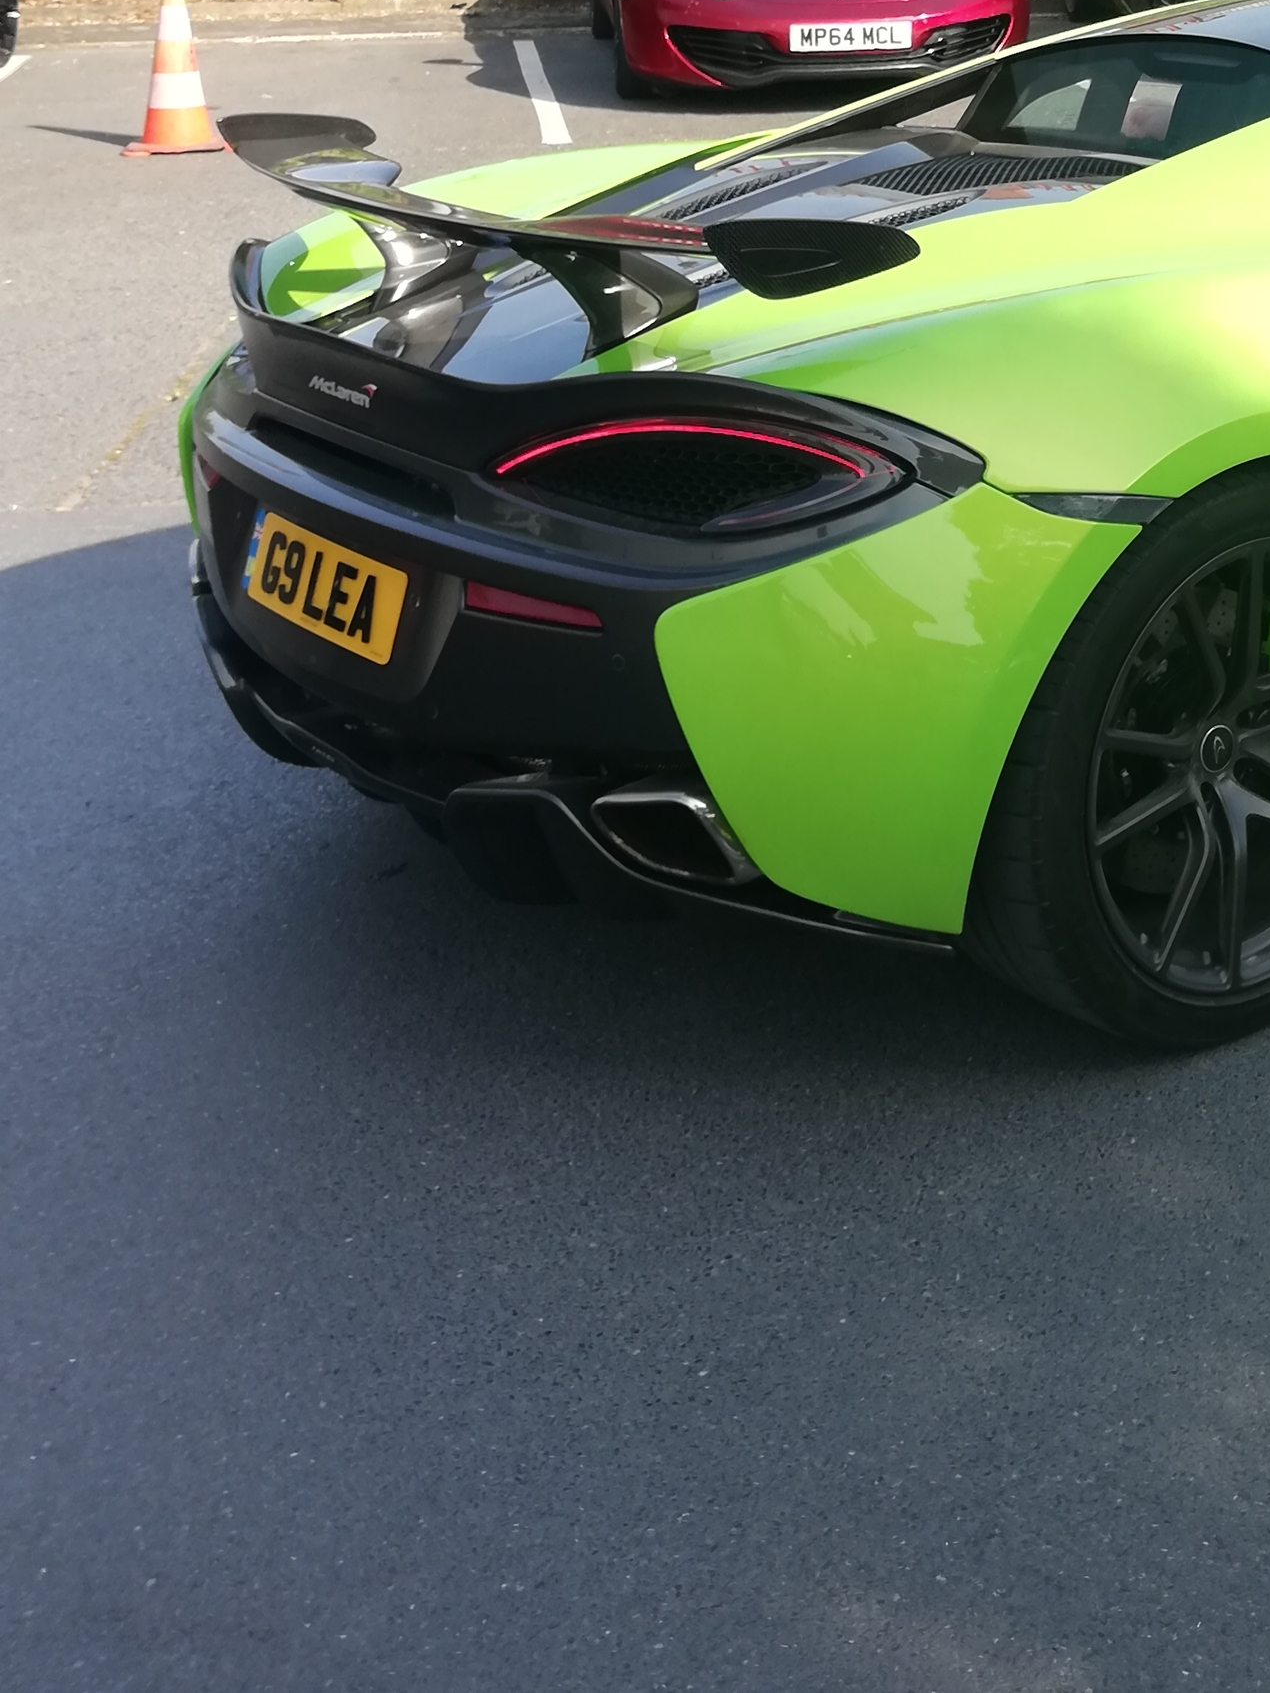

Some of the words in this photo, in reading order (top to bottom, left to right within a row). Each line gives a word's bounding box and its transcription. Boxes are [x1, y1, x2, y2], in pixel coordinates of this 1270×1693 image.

[800, 28, 855, 47] MP64
[862, 26, 902, 45] MCL
[308, 375, 370, 409] McLaren
[261, 531, 306, 605] G9
[302, 551, 377, 644] LEA
